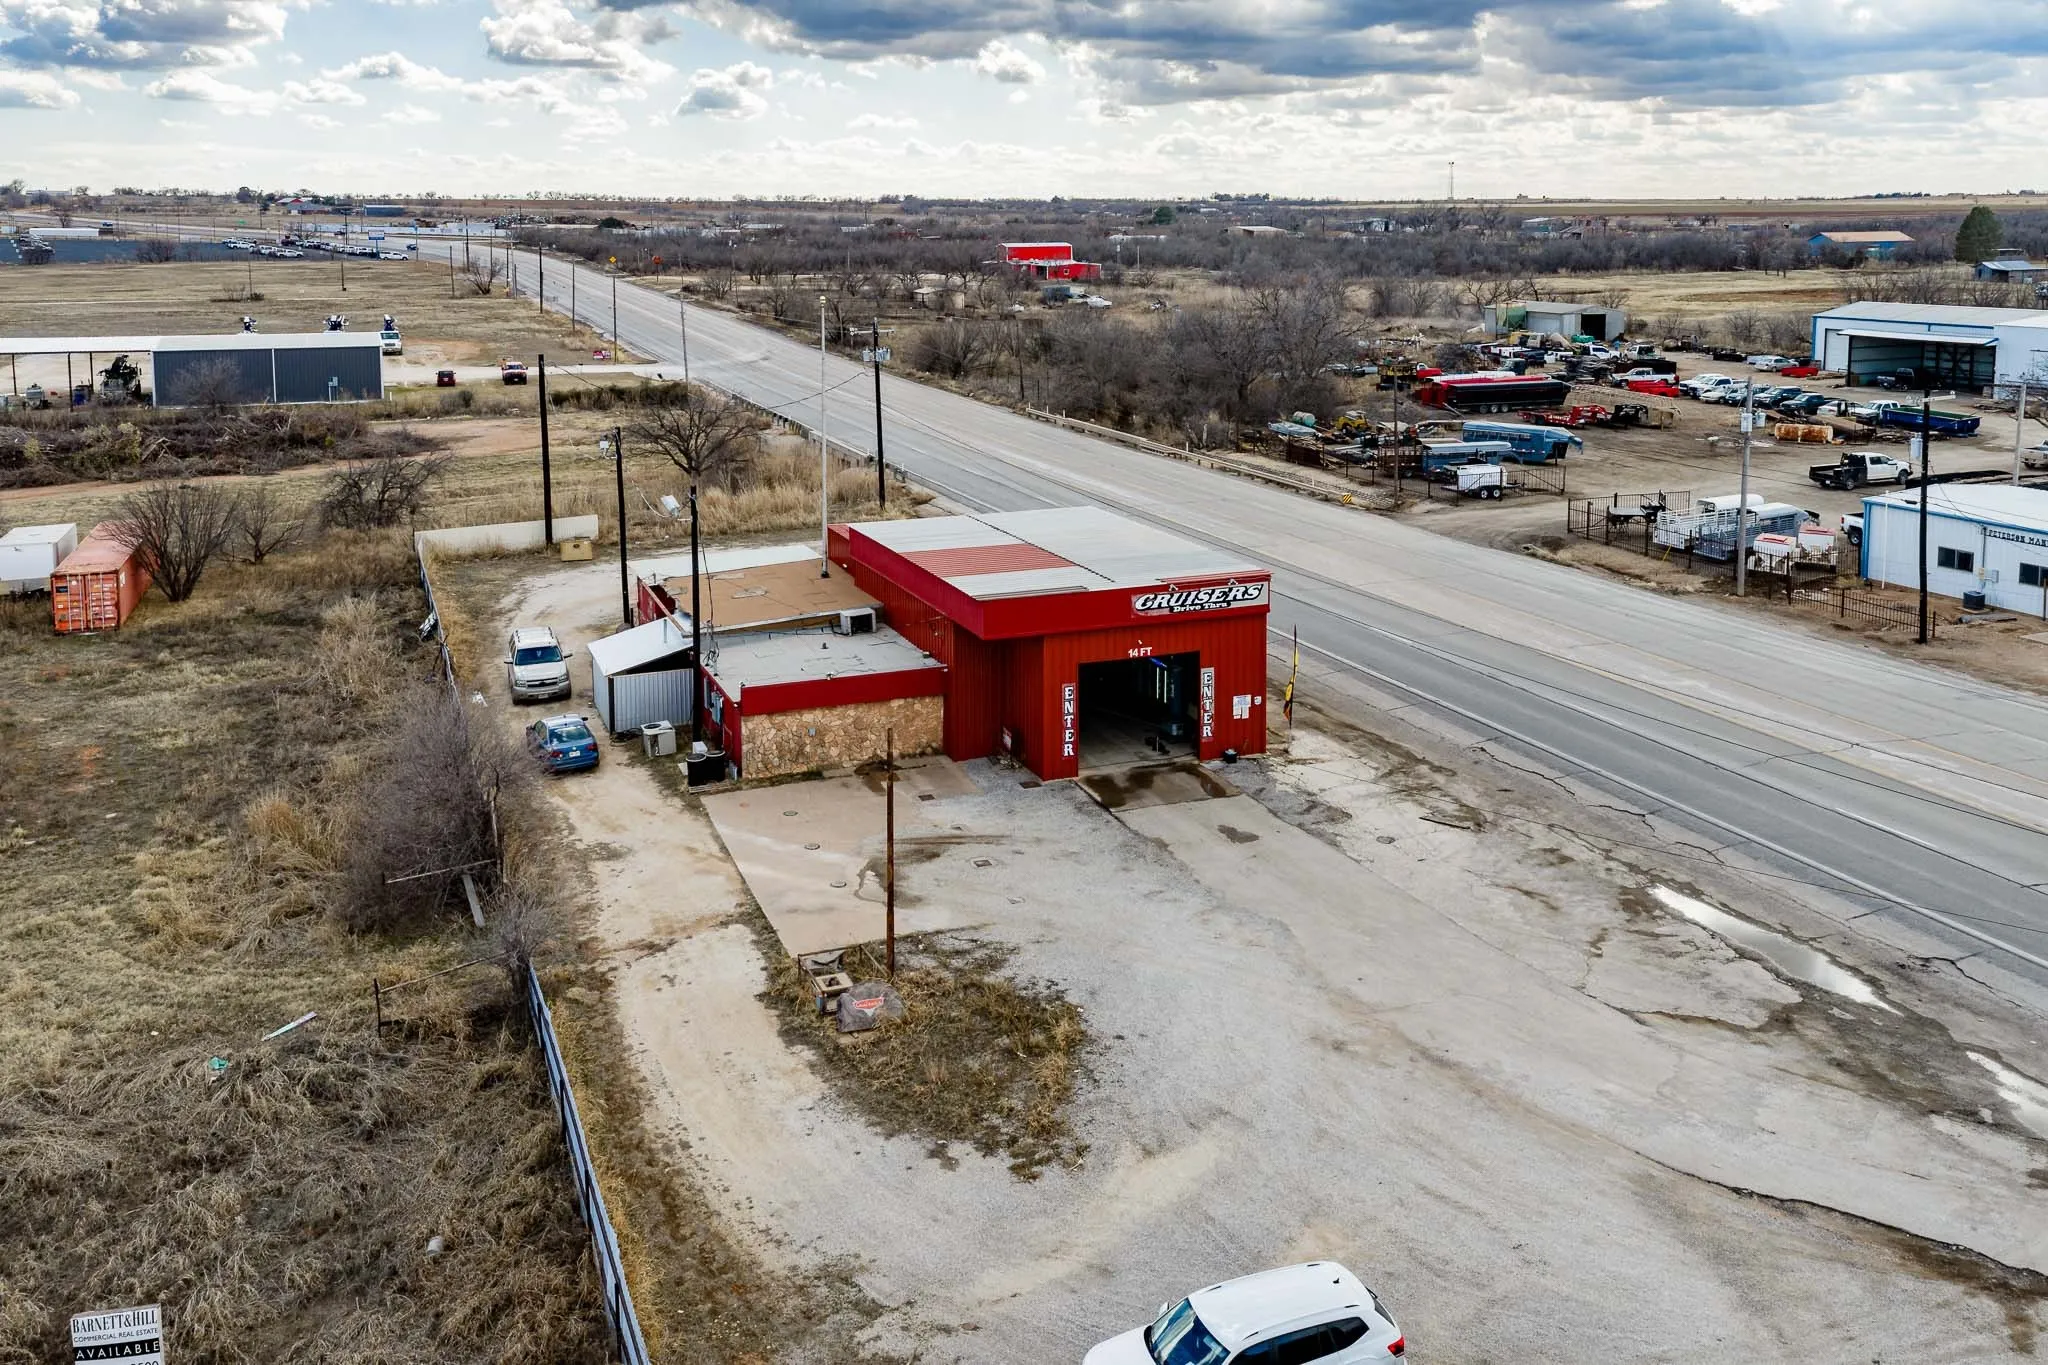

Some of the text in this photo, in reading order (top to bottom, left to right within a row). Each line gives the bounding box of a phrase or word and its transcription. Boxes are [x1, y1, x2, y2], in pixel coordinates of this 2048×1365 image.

[2029, 536, 2048, 547] MAN
[1135, 584, 1263, 611] CRUISERS
[1172, 601, 1228, 613] Drive Thru
[1128, 647, 1152, 658] 14 FT
[1202, 671, 1213, 738] ENTER
[1063, 686, 1075, 757] ENTER
[72, 1311, 157, 1333] BARNETT&HILL
[74, 1334, 116, 1343] COMMERCIAL
[136, 1328, 158, 1336] ESTATE
[76, 1341, 159, 1359] AVAILABLE
